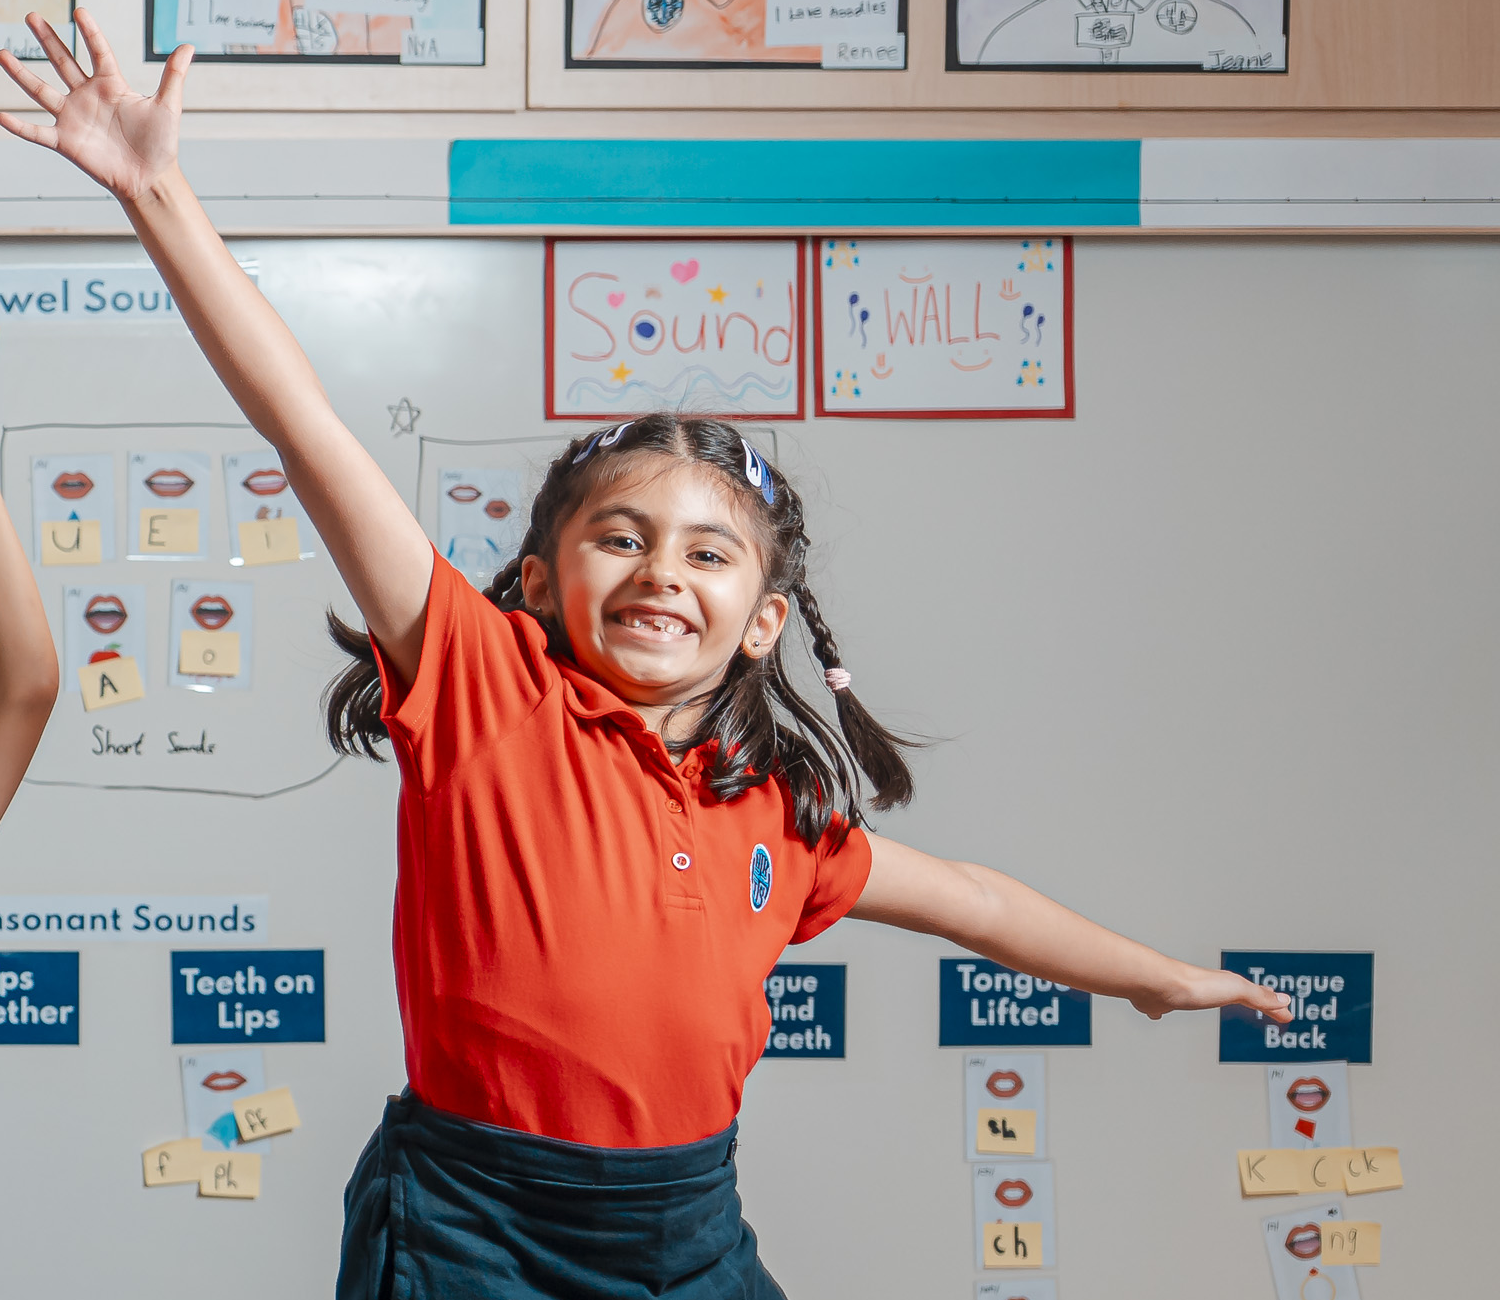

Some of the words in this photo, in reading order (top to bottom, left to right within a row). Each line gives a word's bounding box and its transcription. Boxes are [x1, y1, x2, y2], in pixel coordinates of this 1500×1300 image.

[568, 271, 795, 367] Sound
[884, 280, 1000, 349] WALL
[149, 516, 168, 547] E
[99, 673, 118, 697] A
[91, 727, 143, 757] Short
[134, 905, 256, 934] Sounds
[180, 967, 266, 995] Teeth
[274, 974, 314, 994] on
[1249, 967, 1344, 1000] Tongue
[218, 1002, 280, 1035] Lips
[971, 999, 1061, 1027] Lifted
[1265, 1025, 1327, 1050] Back
[992, 1228, 1028, 1257] ch
[1329, 1230, 1357, 1257] ng
